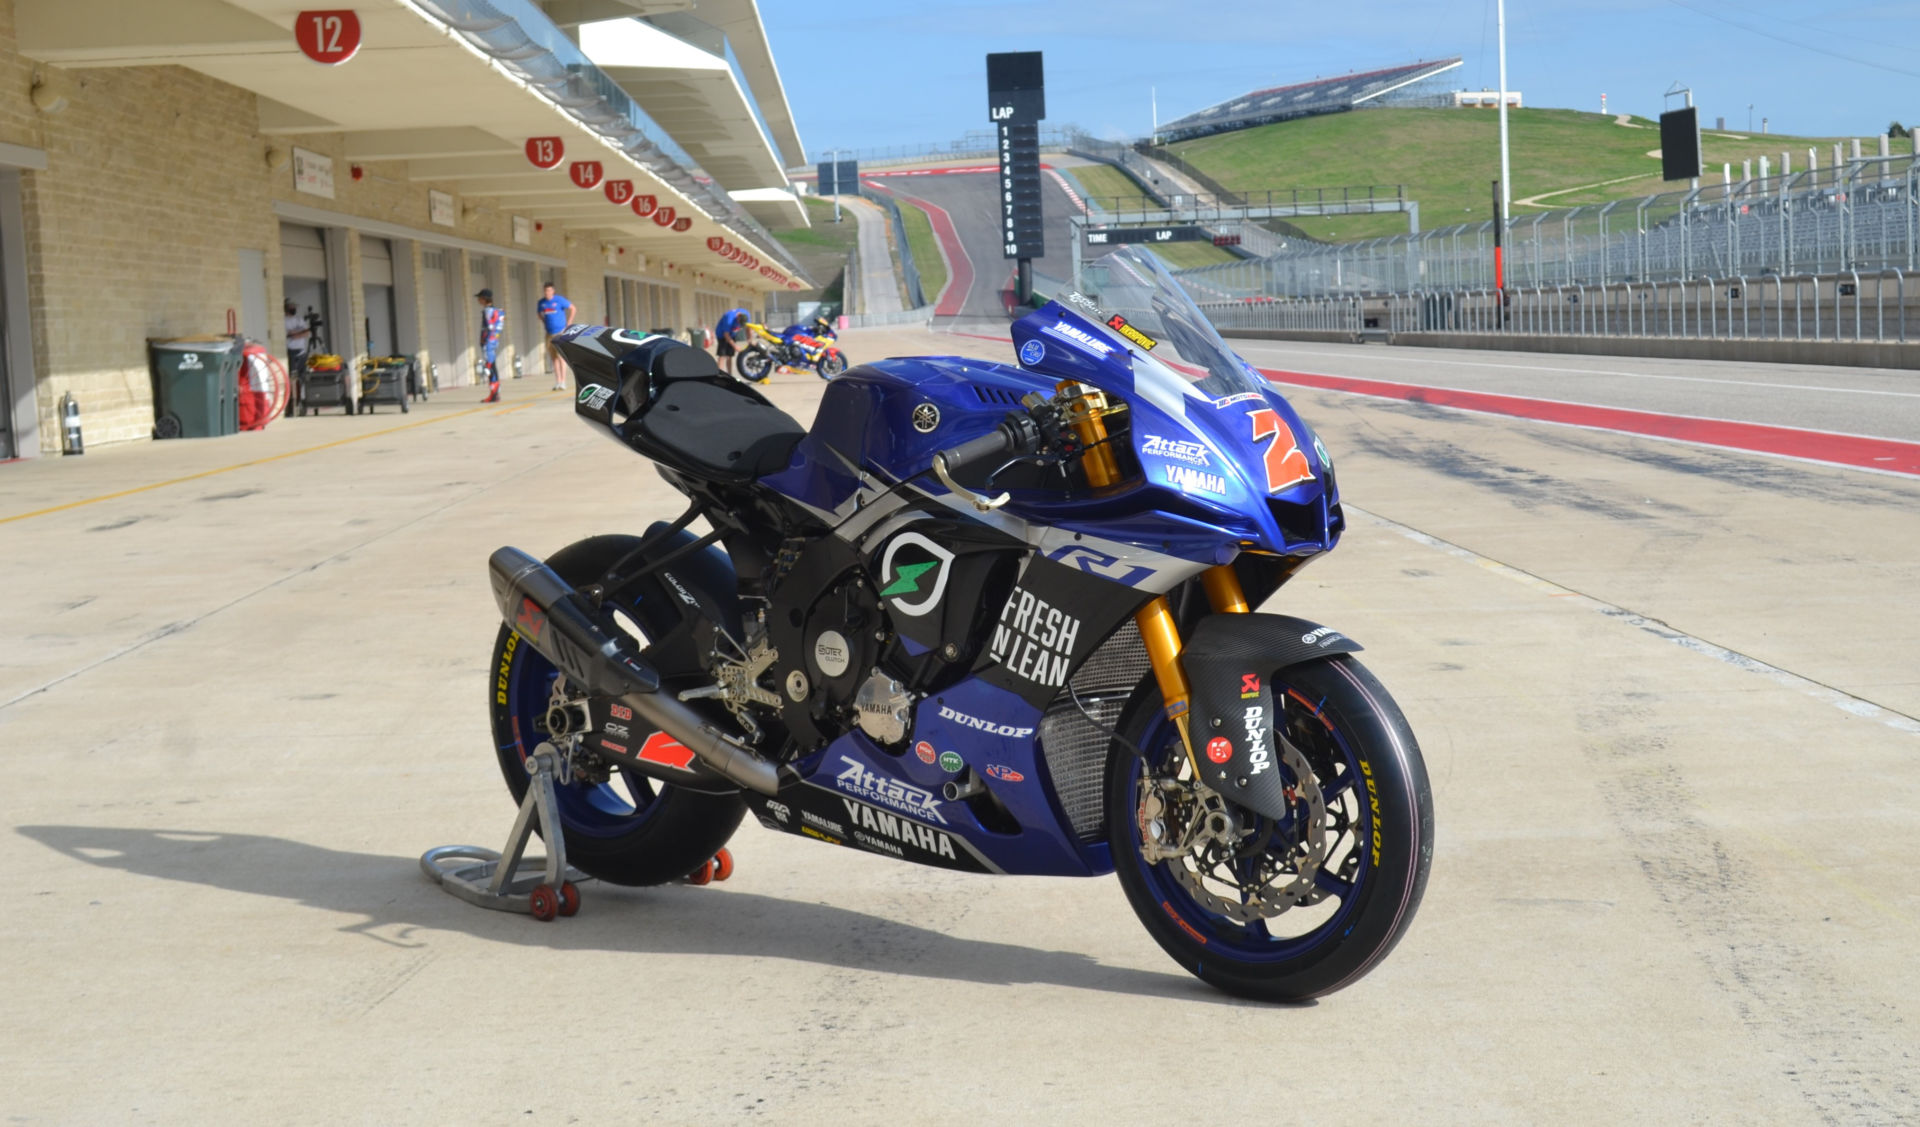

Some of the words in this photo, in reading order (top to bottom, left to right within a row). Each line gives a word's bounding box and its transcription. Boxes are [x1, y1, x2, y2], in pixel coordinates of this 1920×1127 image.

[312, 15, 344, 53] 12
[992, 107, 1014, 119] LAP
[1002, 126, 1009, 136] 1
[535, 140, 555, 163] 13
[1002, 140, 1010, 150] 2
[1003, 153, 1010, 163] 3
[578, 164, 595, 184] 14
[1004, 166, 1011, 175] 4
[612, 182, 627, 200] 15
[1005, 179, 1012, 189] 5
[637, 198, 652, 214] 16
[1005, 192, 1012, 202] 6
[660, 209, 670, 223] 17
[1006, 205, 1013, 215] 7
[1006, 218, 1013, 228] 8
[1007, 231, 1014, 241] 9
[1088, 233, 1108, 243] TIME
[1156, 231, 1172, 240] LAP
[1005, 244, 1017, 255] 10
[1052, 321, 1115, 354] YAMALUBE
[1142, 447, 1205, 465] PERFORMANCE
[1143, 434, 1211, 466] Attack
[1246, 408, 1316, 494] 2
[1165, 464, 1226, 495] YAMAHA
[1000, 586, 1081, 656] FRESH
[825, 655, 845, 663] CLUTCH
[1006, 635, 1071, 688] LEAN
[861, 703, 893, 716] YAMAHA
[938, 705, 1034, 738] DUNLOP
[1243, 706, 1271, 775] DUNLOP
[837, 755, 948, 825] Attack
[837, 779, 936, 822] PERFORMANCE
[1360, 759, 1382, 868] DUNLOP
[842, 798, 957, 860] YAMAHA
[864, 834, 904, 857] YAMAHA
